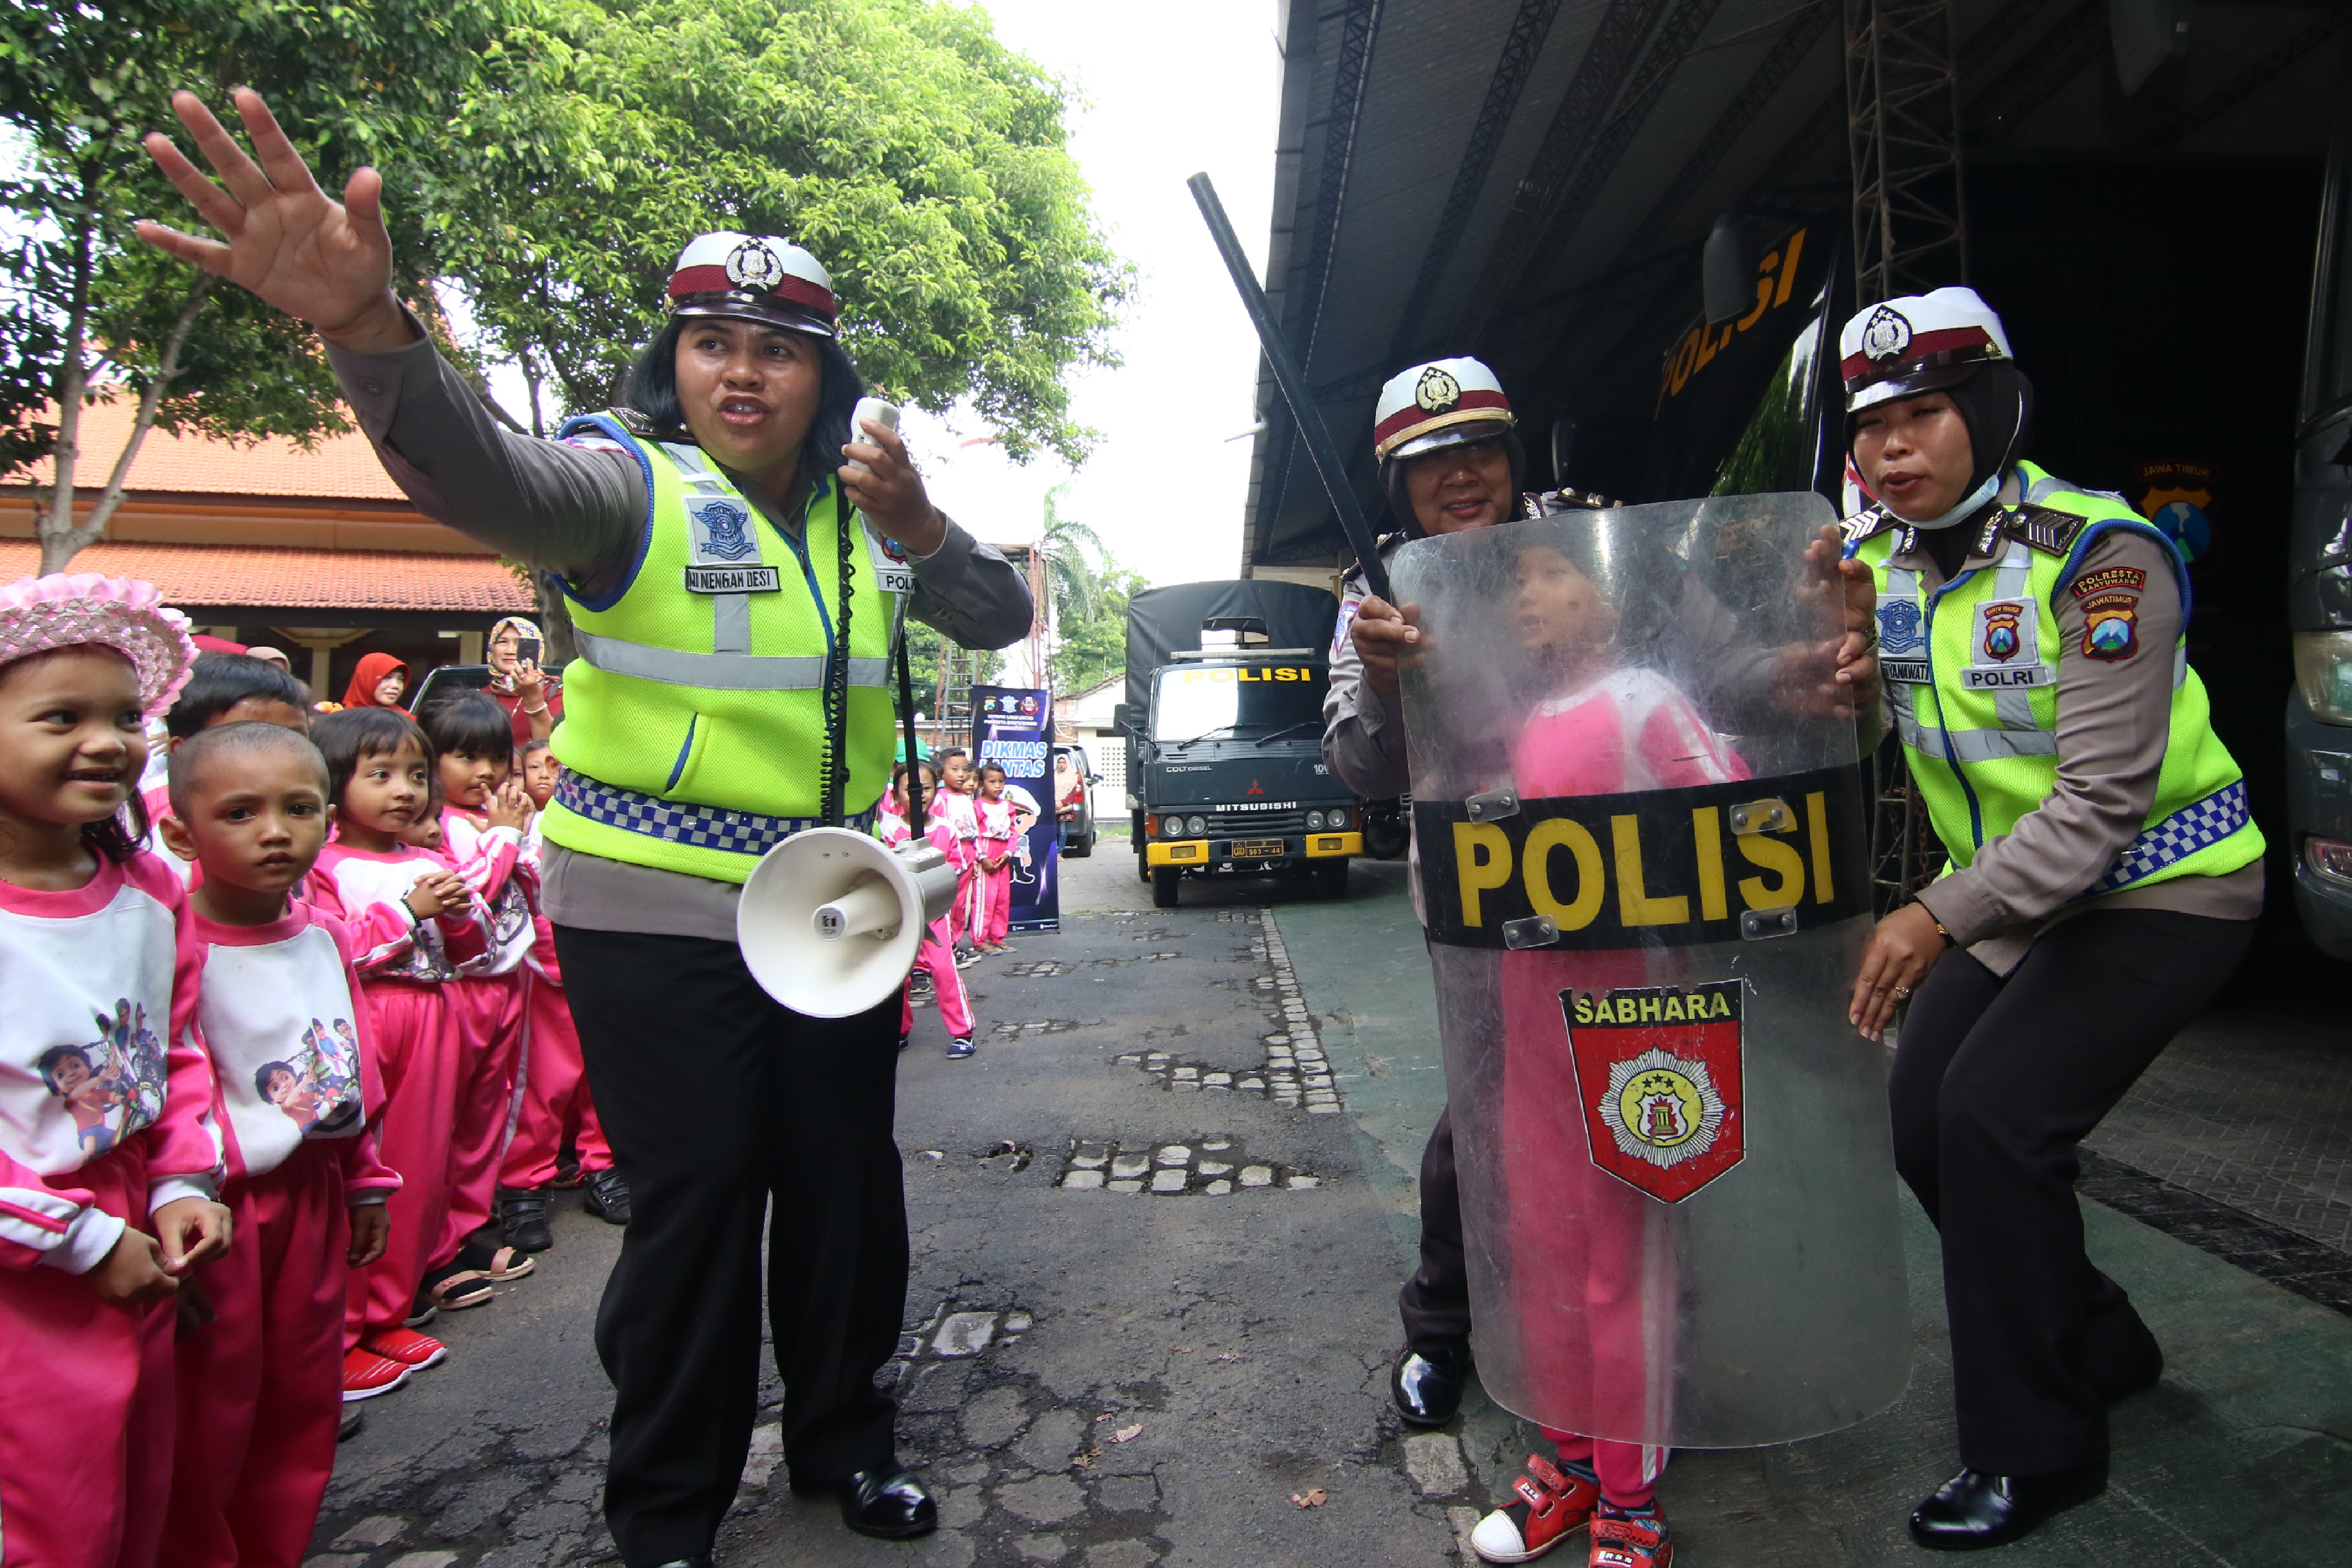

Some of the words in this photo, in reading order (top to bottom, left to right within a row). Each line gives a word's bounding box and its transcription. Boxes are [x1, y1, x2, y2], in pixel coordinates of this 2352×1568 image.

[2143, 464, 2173, 477] JAWA
[2175, 464, 2211, 477] TIMUR
[689, 571, 699, 587] NI
[700, 572, 744, 589] NENGAH
[747, 570, 770, 587] DESI
[2078, 570, 2139, 589] POLRESTA
[1182, 667, 1311, 684] POLISI
[1971, 670, 2033, 686] POLRI
[981, 740, 1048, 759] DIKMAS
[1216, 801, 1297, 811] MITSUBISHI
[1452, 791, 1835, 932] POLISI
[1575, 992, 1731, 1023] SABHARA
